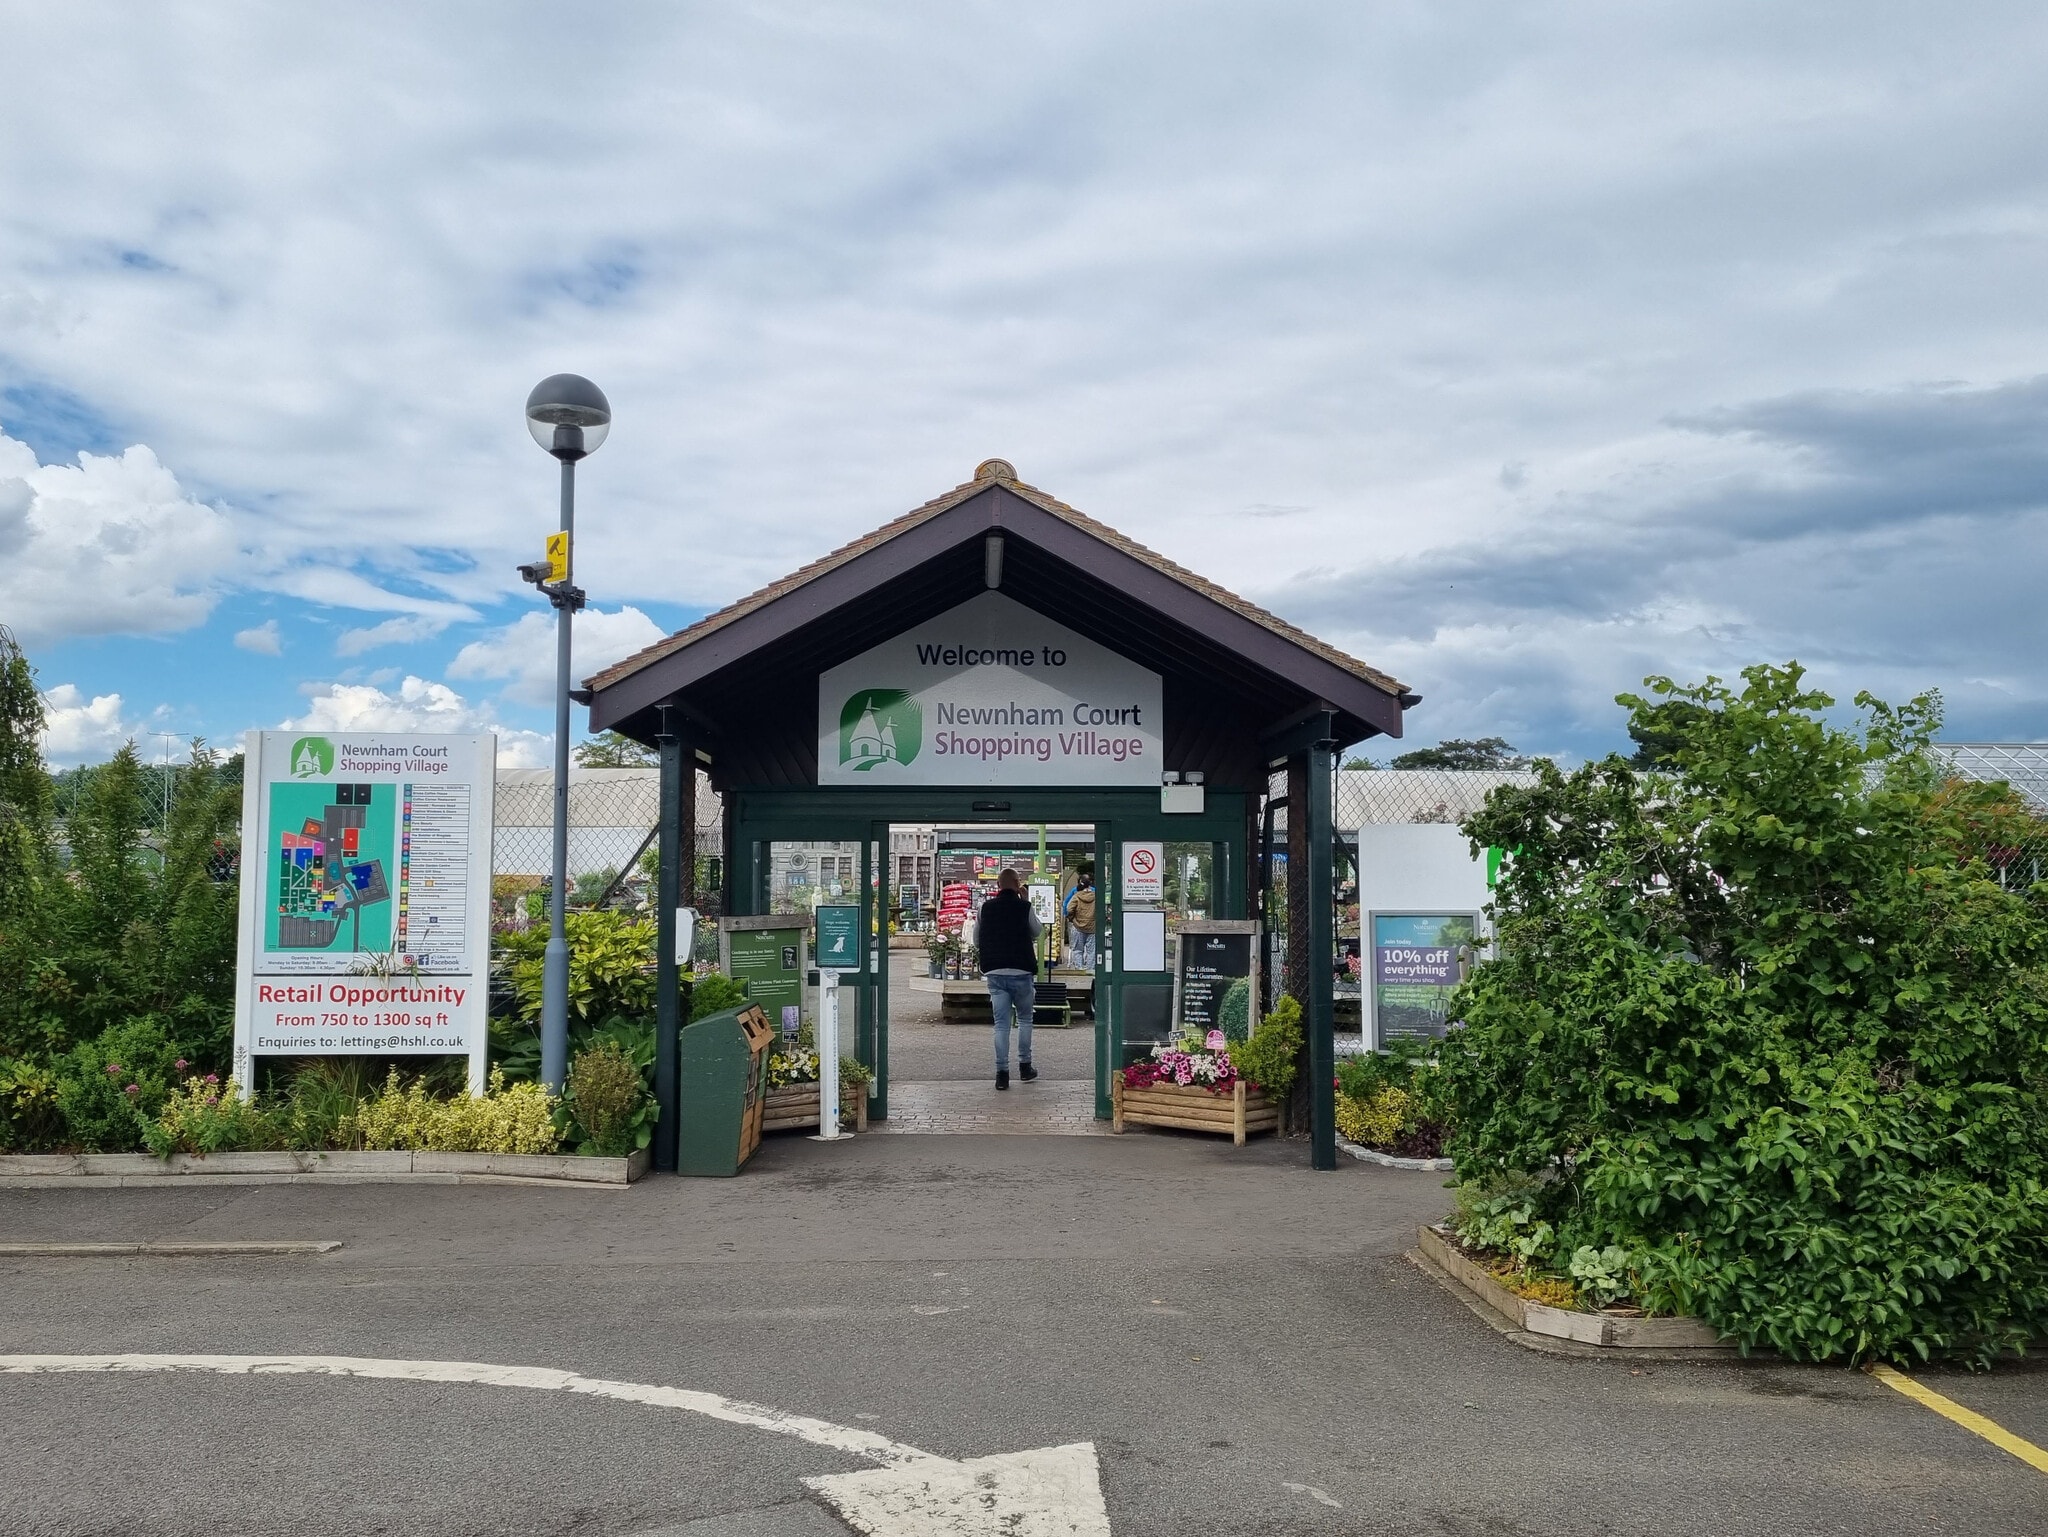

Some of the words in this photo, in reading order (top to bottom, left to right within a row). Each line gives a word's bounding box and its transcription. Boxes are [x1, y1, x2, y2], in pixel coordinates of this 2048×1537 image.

[916, 644, 1035, 666] Welcome
[1042, 646, 1067, 667] to
[937, 702, 1064, 726] Newnham
[1072, 703, 1142, 726] Court
[341, 744, 408, 757] Newnham
[412, 745, 448, 757] Court
[935, 731, 1051, 762] Shopping
[1058, 732, 1143, 762] Village
[340, 758, 401, 774] Shopping
[405, 759, 448, 775] Village
[1034, 877, 1049, 885] Map
[1413, 923, 1438, 931] Notcutts
[1384, 949, 1421, 963] 10%
[1425, 950, 1450, 963] off
[1185, 965, 1196, 973] Our
[1196, 965, 1218, 973] Lifetime
[1198, 972, 1224, 980] Guarantee
[258, 983, 322, 1003] Retail
[329, 984, 466, 1007] Opportunity
[275, 1013, 315, 1026] From
[320, 1013, 348, 1026] 750
[352, 1014, 369, 1026] to
[374, 1013, 410, 1026] 1300
[414, 1016, 431, 1028] sq
[435, 1012, 448, 1026] ft
[258, 1036, 316, 1049] Enquiries
[319, 1037, 337, 1047] to:
[340, 1035, 464, 1050] lettings@hshl.co.uk
